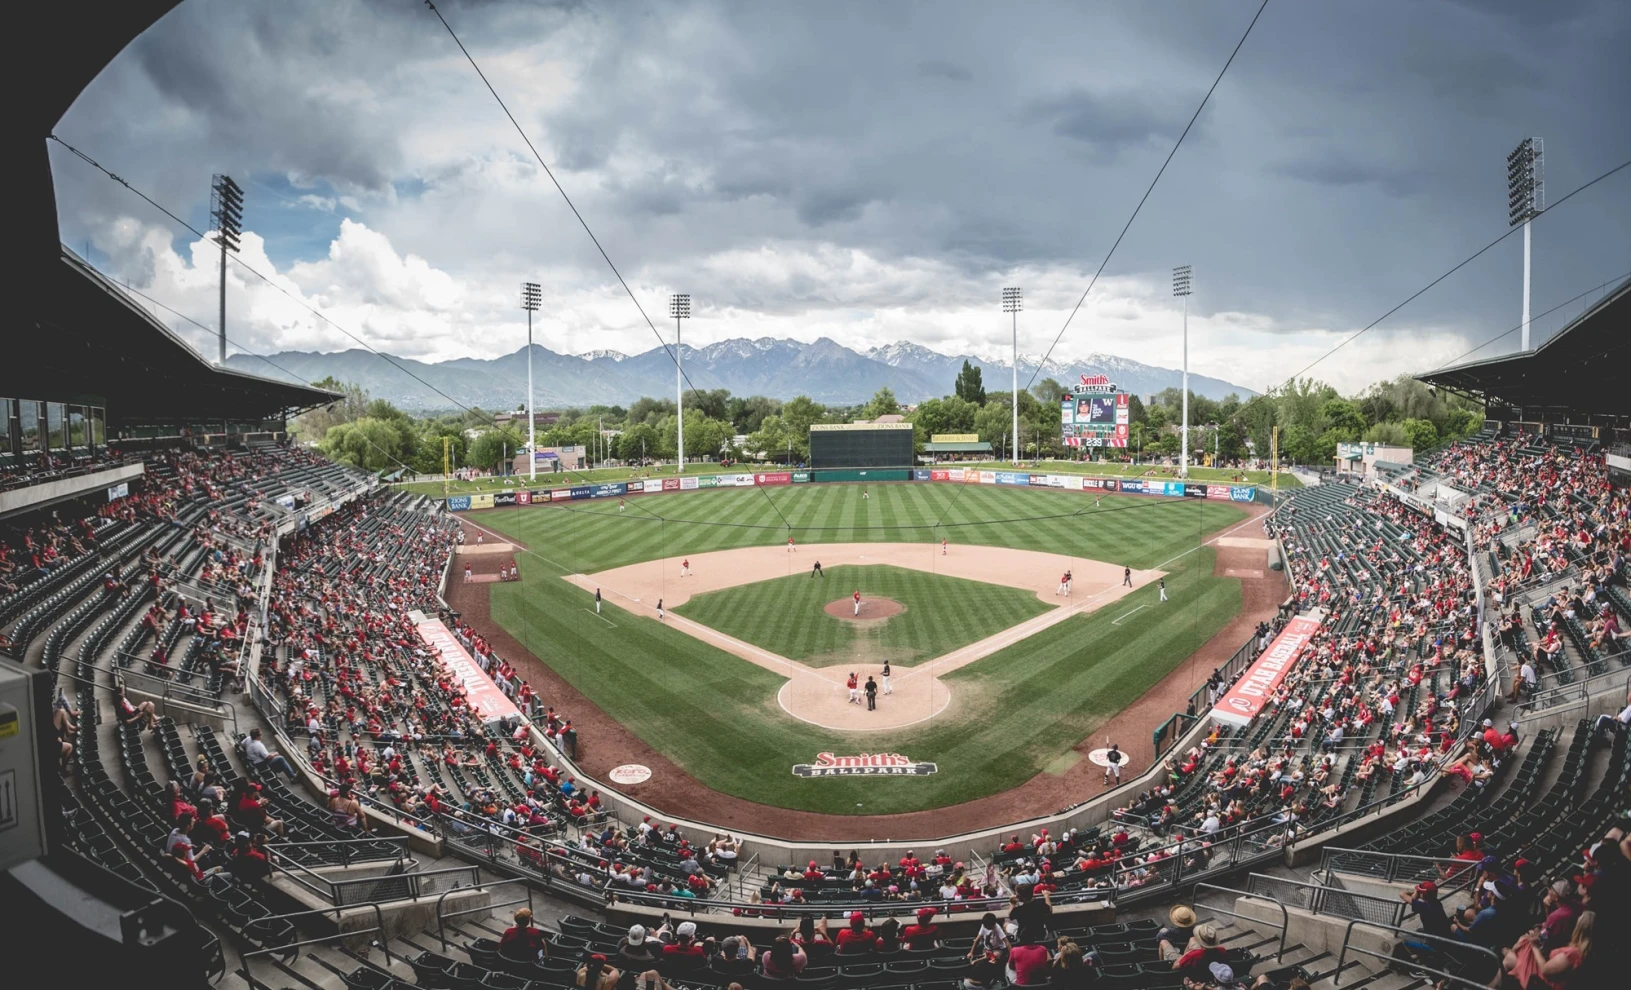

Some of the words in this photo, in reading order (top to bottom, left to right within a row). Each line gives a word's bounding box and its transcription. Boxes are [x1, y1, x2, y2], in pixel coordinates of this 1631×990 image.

[1081, 374, 1108, 385] Smith's
[1103, 398, 1113, 406] W
[1238, 668, 1278, 696] UTAH
[1260, 632, 1308, 671] BASEBALL
[816, 752, 909, 767] Smith's
[811, 767, 917, 776] BALLPARK
[666, 832, 674, 841] 28
